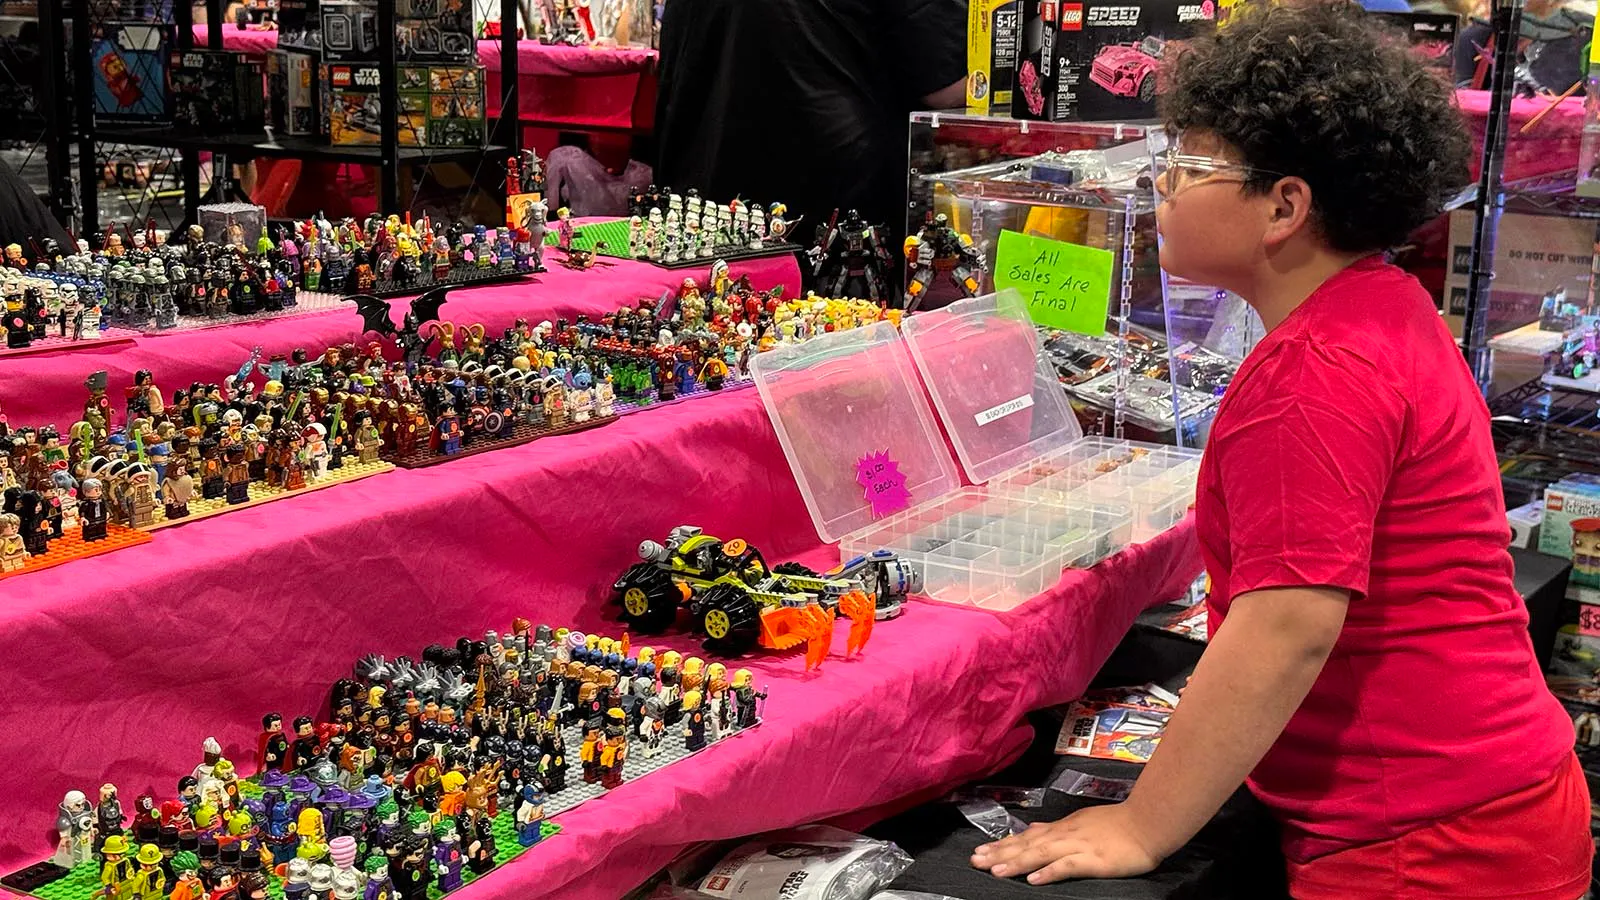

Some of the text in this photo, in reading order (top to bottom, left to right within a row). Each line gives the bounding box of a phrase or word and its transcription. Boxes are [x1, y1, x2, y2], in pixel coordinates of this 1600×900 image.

[1063, 10, 1082, 22] LEGO
[1087, 7, 1140, 20] SPEED
[1041, 26, 1052, 76] SPEED
[1060, 57, 1070, 68] 9+
[354, 69, 380, 77] STA
[1034, 250, 1060, 266] All
[1509, 250, 1522, 259] DO
[1525, 251, 1545, 261] NOT
[1547, 253, 1566, 263] CUT
[1009, 265, 1090, 293] Sales Are
[1031, 290, 1077, 312] Final
[779, 870, 802, 895] STAR
